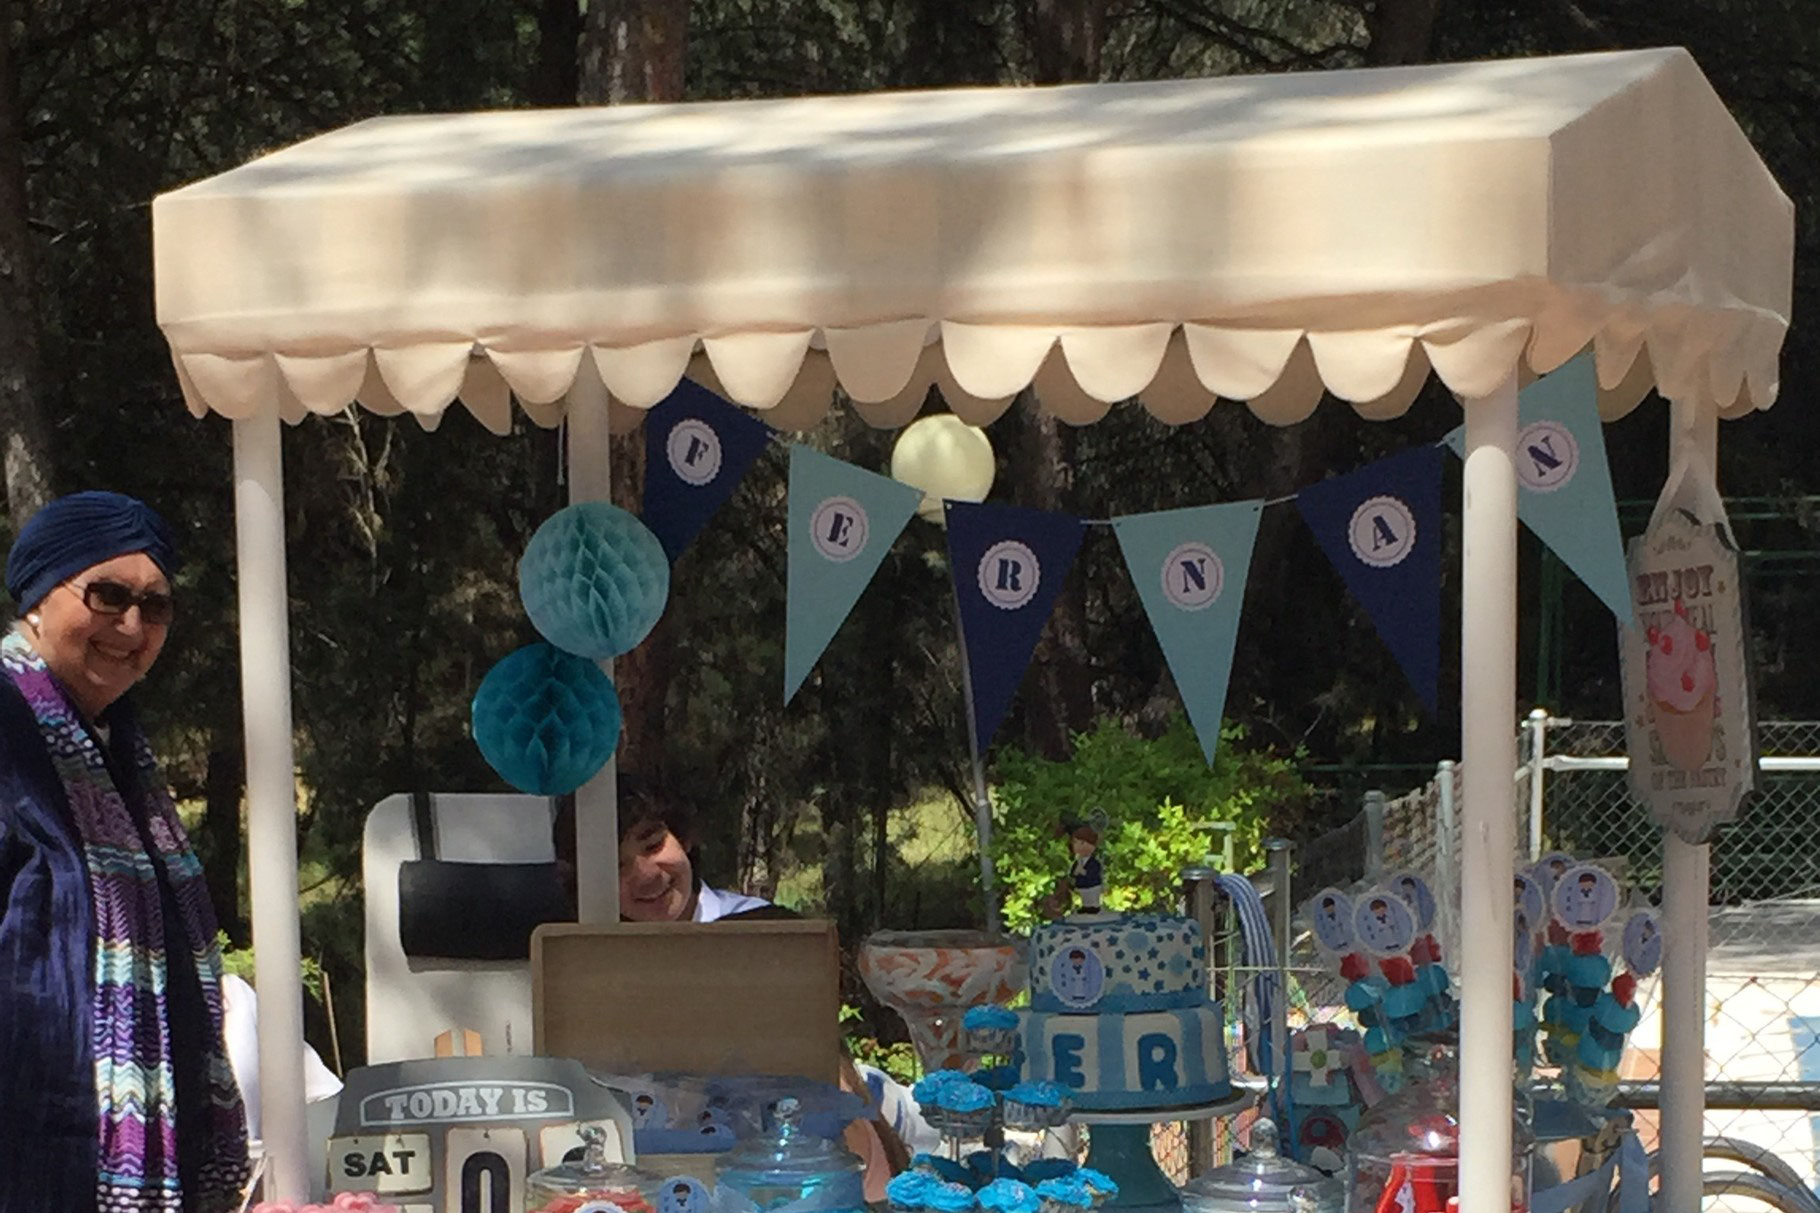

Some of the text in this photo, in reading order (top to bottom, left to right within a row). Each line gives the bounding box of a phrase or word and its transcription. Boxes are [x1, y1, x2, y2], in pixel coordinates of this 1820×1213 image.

[684, 433, 711, 468] F
[826, 512, 854, 548] E
[994, 557, 1022, 592] R
[1180, 557, 1207, 594] N
[1371, 514, 1398, 551] A
[385, 1087, 549, 1120] TODAY IS
[344, 1151, 416, 1177] SAT
